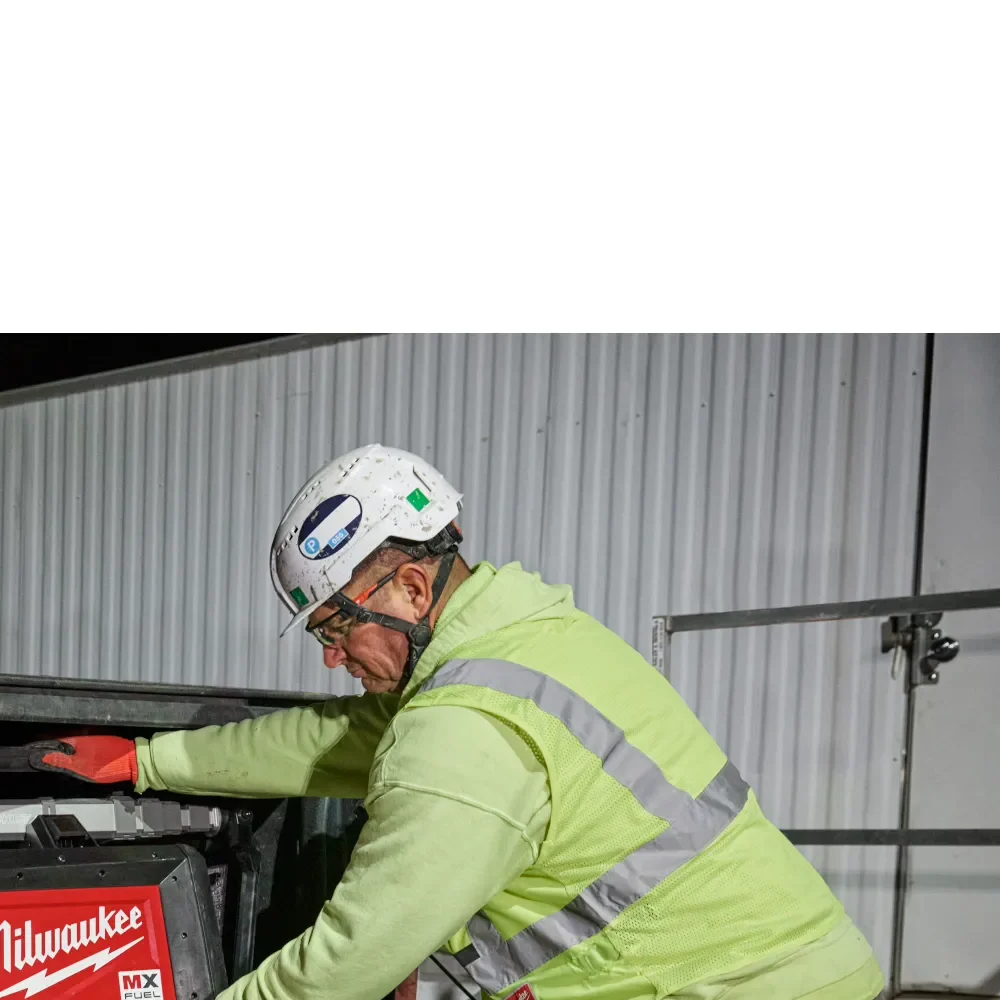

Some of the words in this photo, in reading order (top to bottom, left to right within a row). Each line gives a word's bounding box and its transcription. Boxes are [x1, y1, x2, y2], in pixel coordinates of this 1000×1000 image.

[307, 540, 315, 552] P
[123, 974, 159, 989] MX
[125, 991, 161, 1000] FUEL
